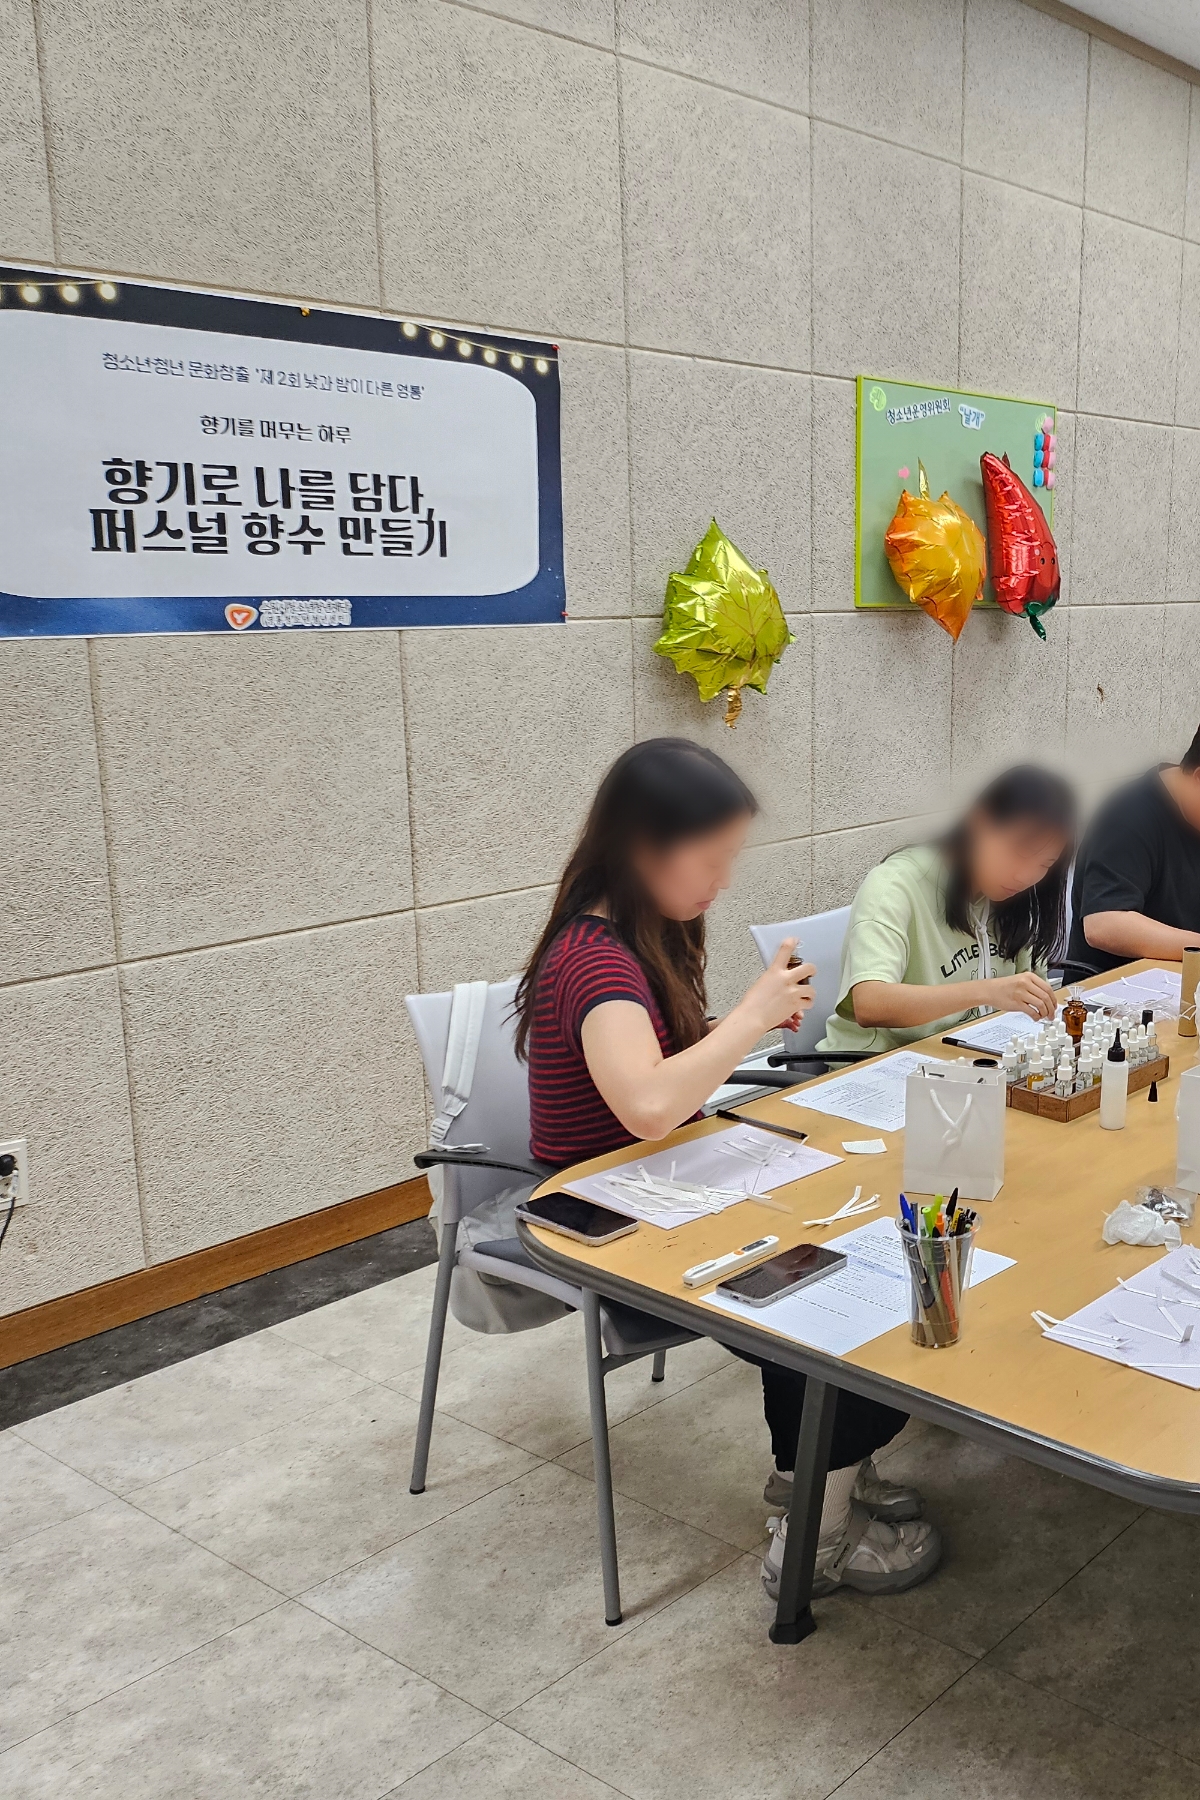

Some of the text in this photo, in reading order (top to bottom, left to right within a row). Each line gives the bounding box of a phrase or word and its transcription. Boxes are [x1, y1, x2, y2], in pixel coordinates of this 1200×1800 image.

[188, 360, 249, 383] 문화창출
[335, 376, 364, 395] 밤이
[366, 380, 394, 398] 다른
[200, 414, 352, 444] 향기를 머무는 하루
[887, 398, 951, 425] 청소년운영위원회
[101, 457, 243, 507] 향기로
[255, 466, 336, 512] 나를
[88, 508, 448, 558] 퍼스널 향수 만들기
[940, 943, 980, 978] LITTLE
